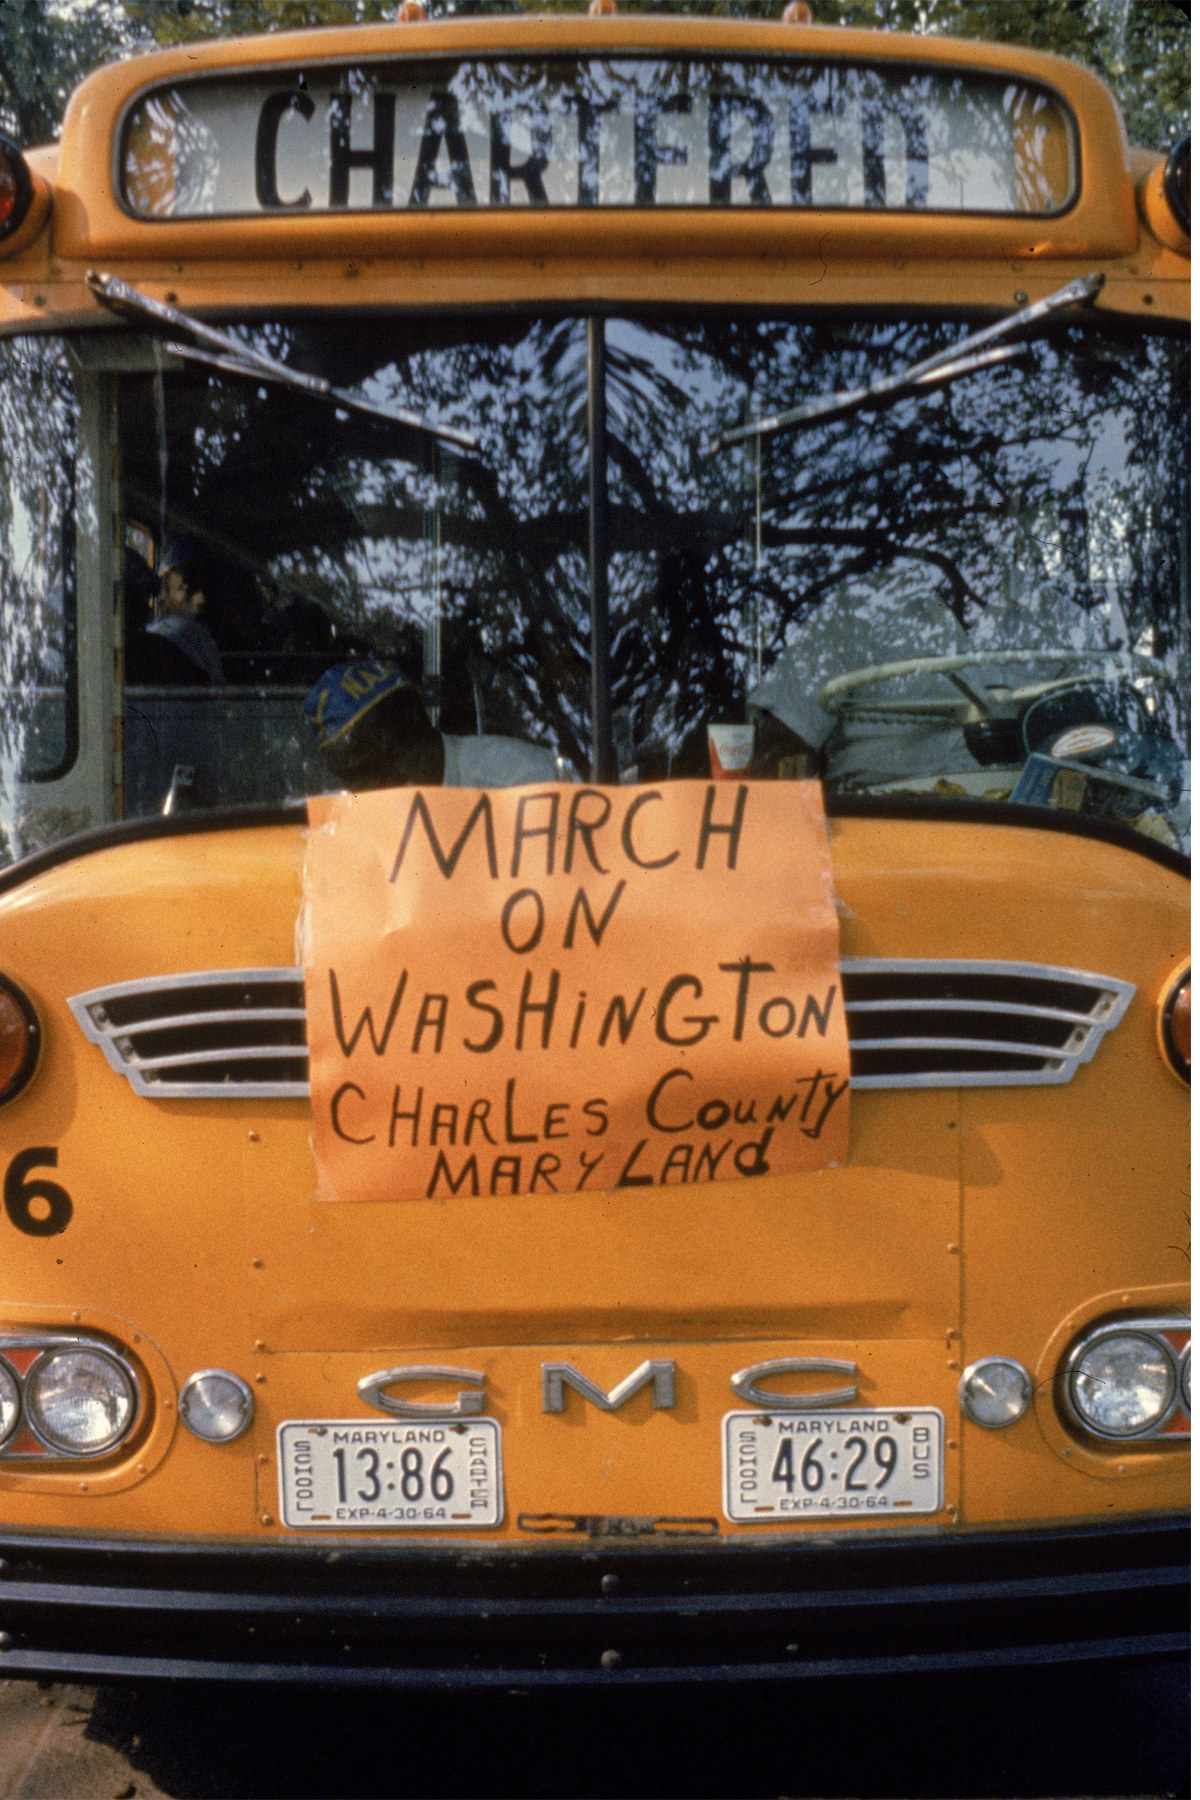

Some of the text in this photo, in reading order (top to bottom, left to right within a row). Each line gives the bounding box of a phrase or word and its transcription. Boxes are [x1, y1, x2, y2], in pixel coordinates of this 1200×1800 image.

[389, 784, 748, 883] MARCH
[501, 879, 627, 954] ON
[329, 1077, 609, 1148] CHARLES
[3, 1146, 74, 1237] 6
[333, 1429, 446, 1444] MARYLAND
[778, 1419, 890, 1434] MARYLAND
[913, 1427, 930, 1479] BUS
[294, 1440, 313, 1512] SCHOOL
[332, 1447, 455, 1503] 13:86
[469, 1437, 489, 1509] CHARTER
[739, 1431, 758, 1503] SCHOOL
[772, 1435, 898, 1493] 46:29
